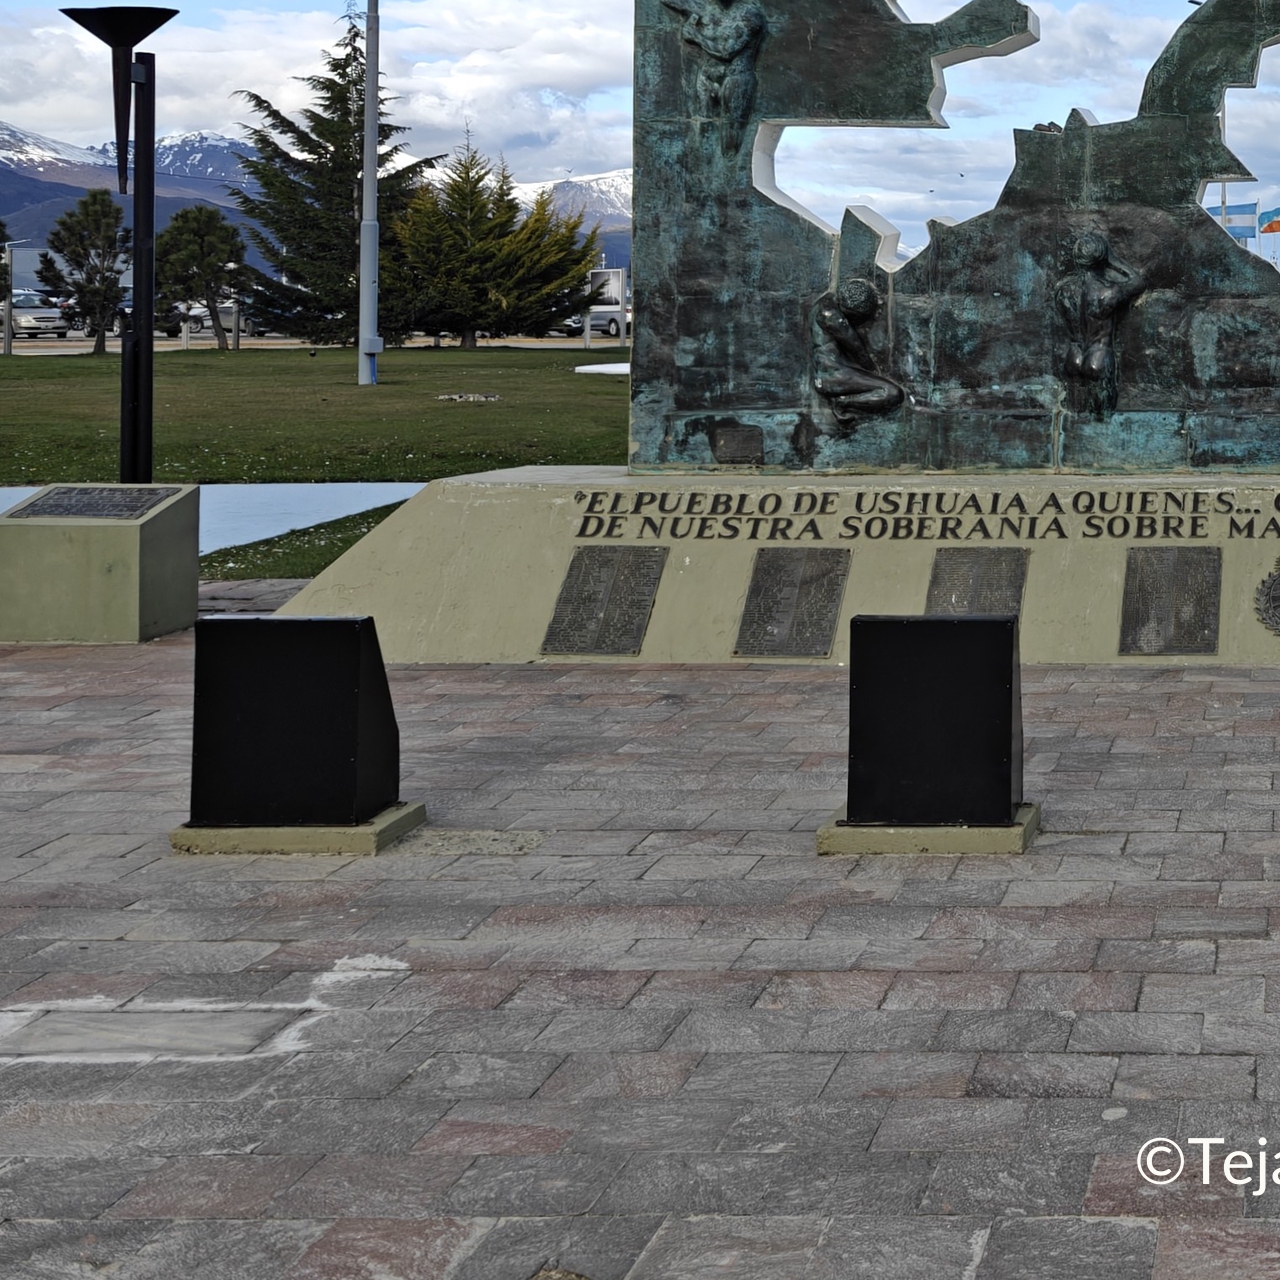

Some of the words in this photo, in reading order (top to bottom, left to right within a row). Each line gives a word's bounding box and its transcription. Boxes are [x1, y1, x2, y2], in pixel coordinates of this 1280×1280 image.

[630, 491, 783, 516] PUEBLO
[790, 492, 840, 516] DE
[854, 492, 1030, 516] USHUAIA
[1037, 492, 1067, 516] A
[1072, 490, 1262, 515] QUIENES...
[575, 515, 628, 539] DE
[636, 516, 824, 540] NUESTRA
[838, 515, 1069, 541] SOBERANIA
[1082, 515, 1210, 540] SOBRE
